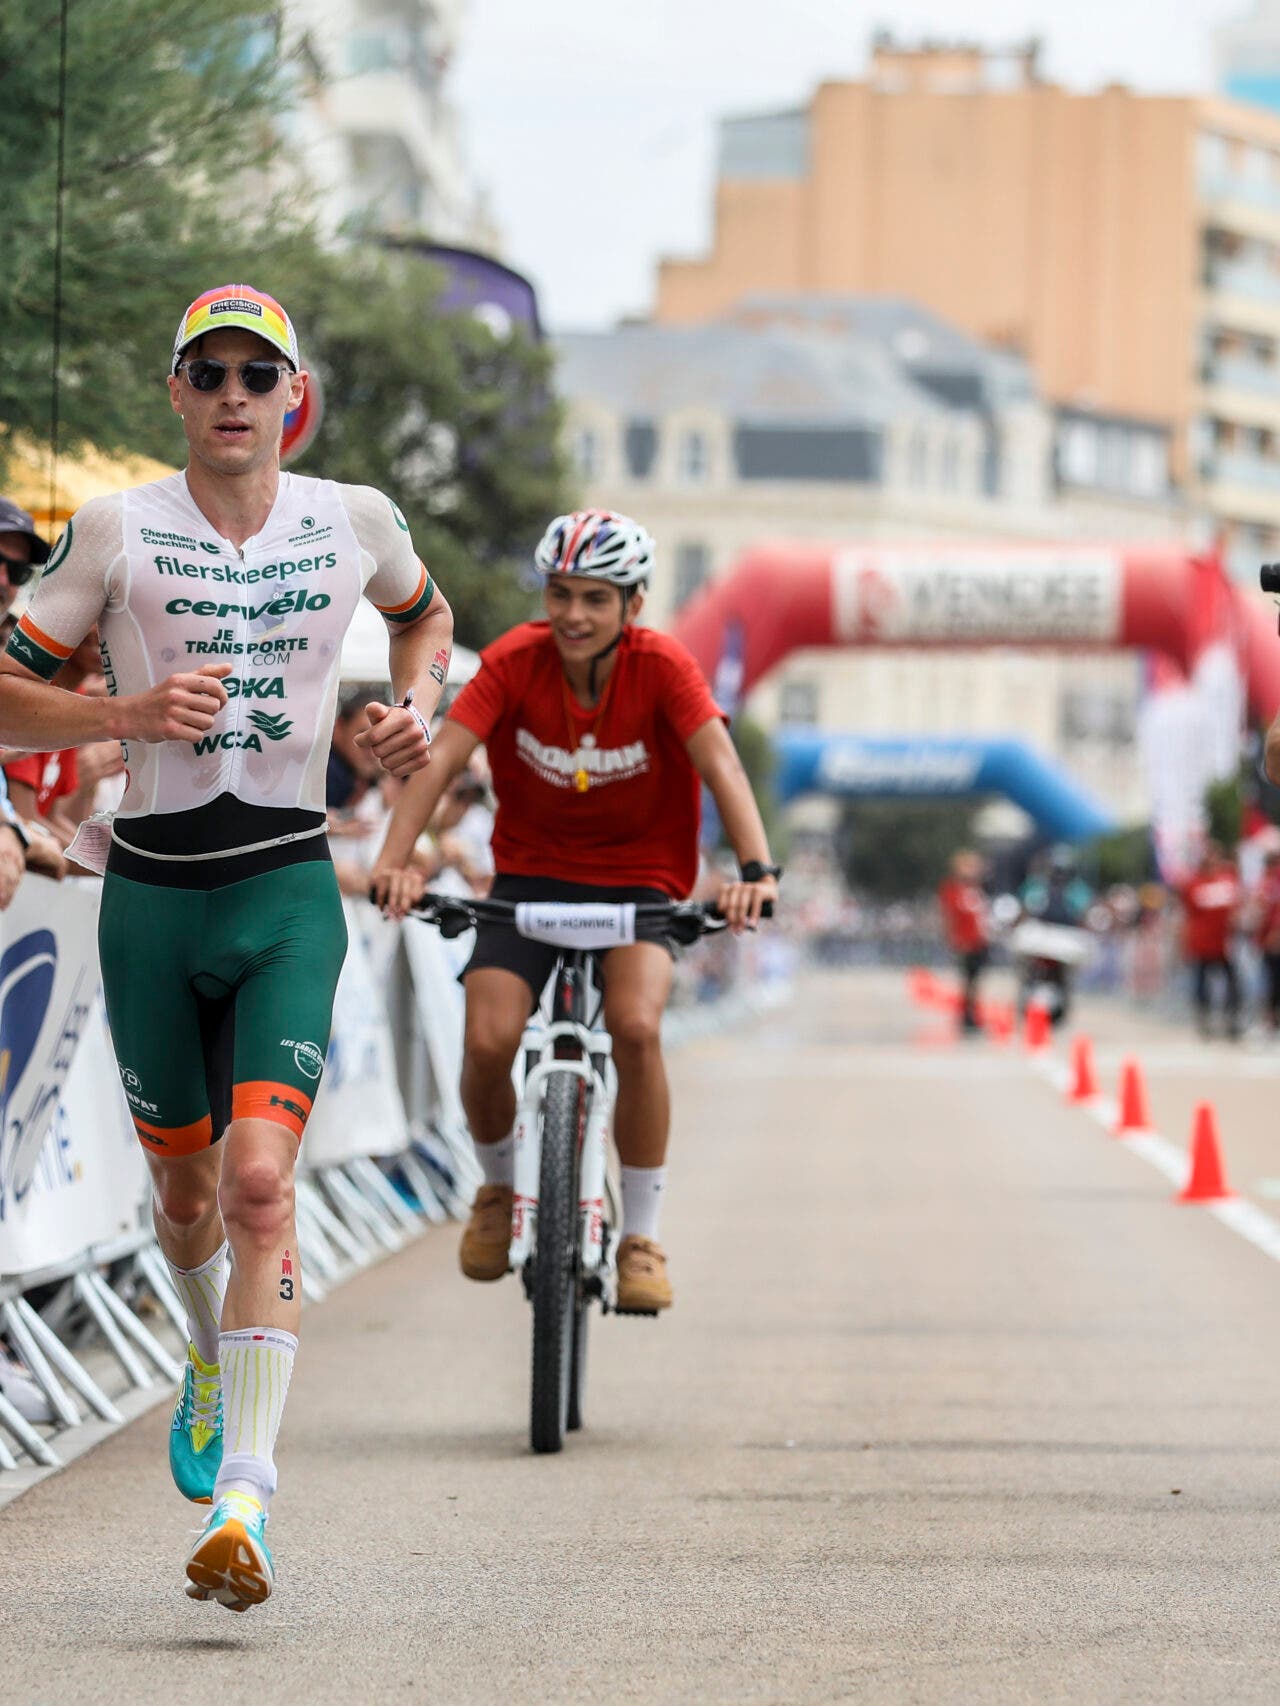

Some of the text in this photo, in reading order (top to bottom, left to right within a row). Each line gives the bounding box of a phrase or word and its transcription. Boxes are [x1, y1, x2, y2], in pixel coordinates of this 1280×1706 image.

[211, 300, 261, 311] PRECISION
[140, 528, 197, 543] Cheetham
[288, 526, 333, 542] ENDURA
[142, 536, 197, 551] Coaching
[153, 552, 337, 585] filerskeepers
[165, 589, 331, 621] cervélo
[212, 629, 234, 641] JE
[248, 653, 291, 667] .COM
[220, 676, 286, 699] OKA
[193, 731, 263, 757] WCA
[280, 1039, 296, 1047] LES
[279, 1277, 294, 1301] 3
